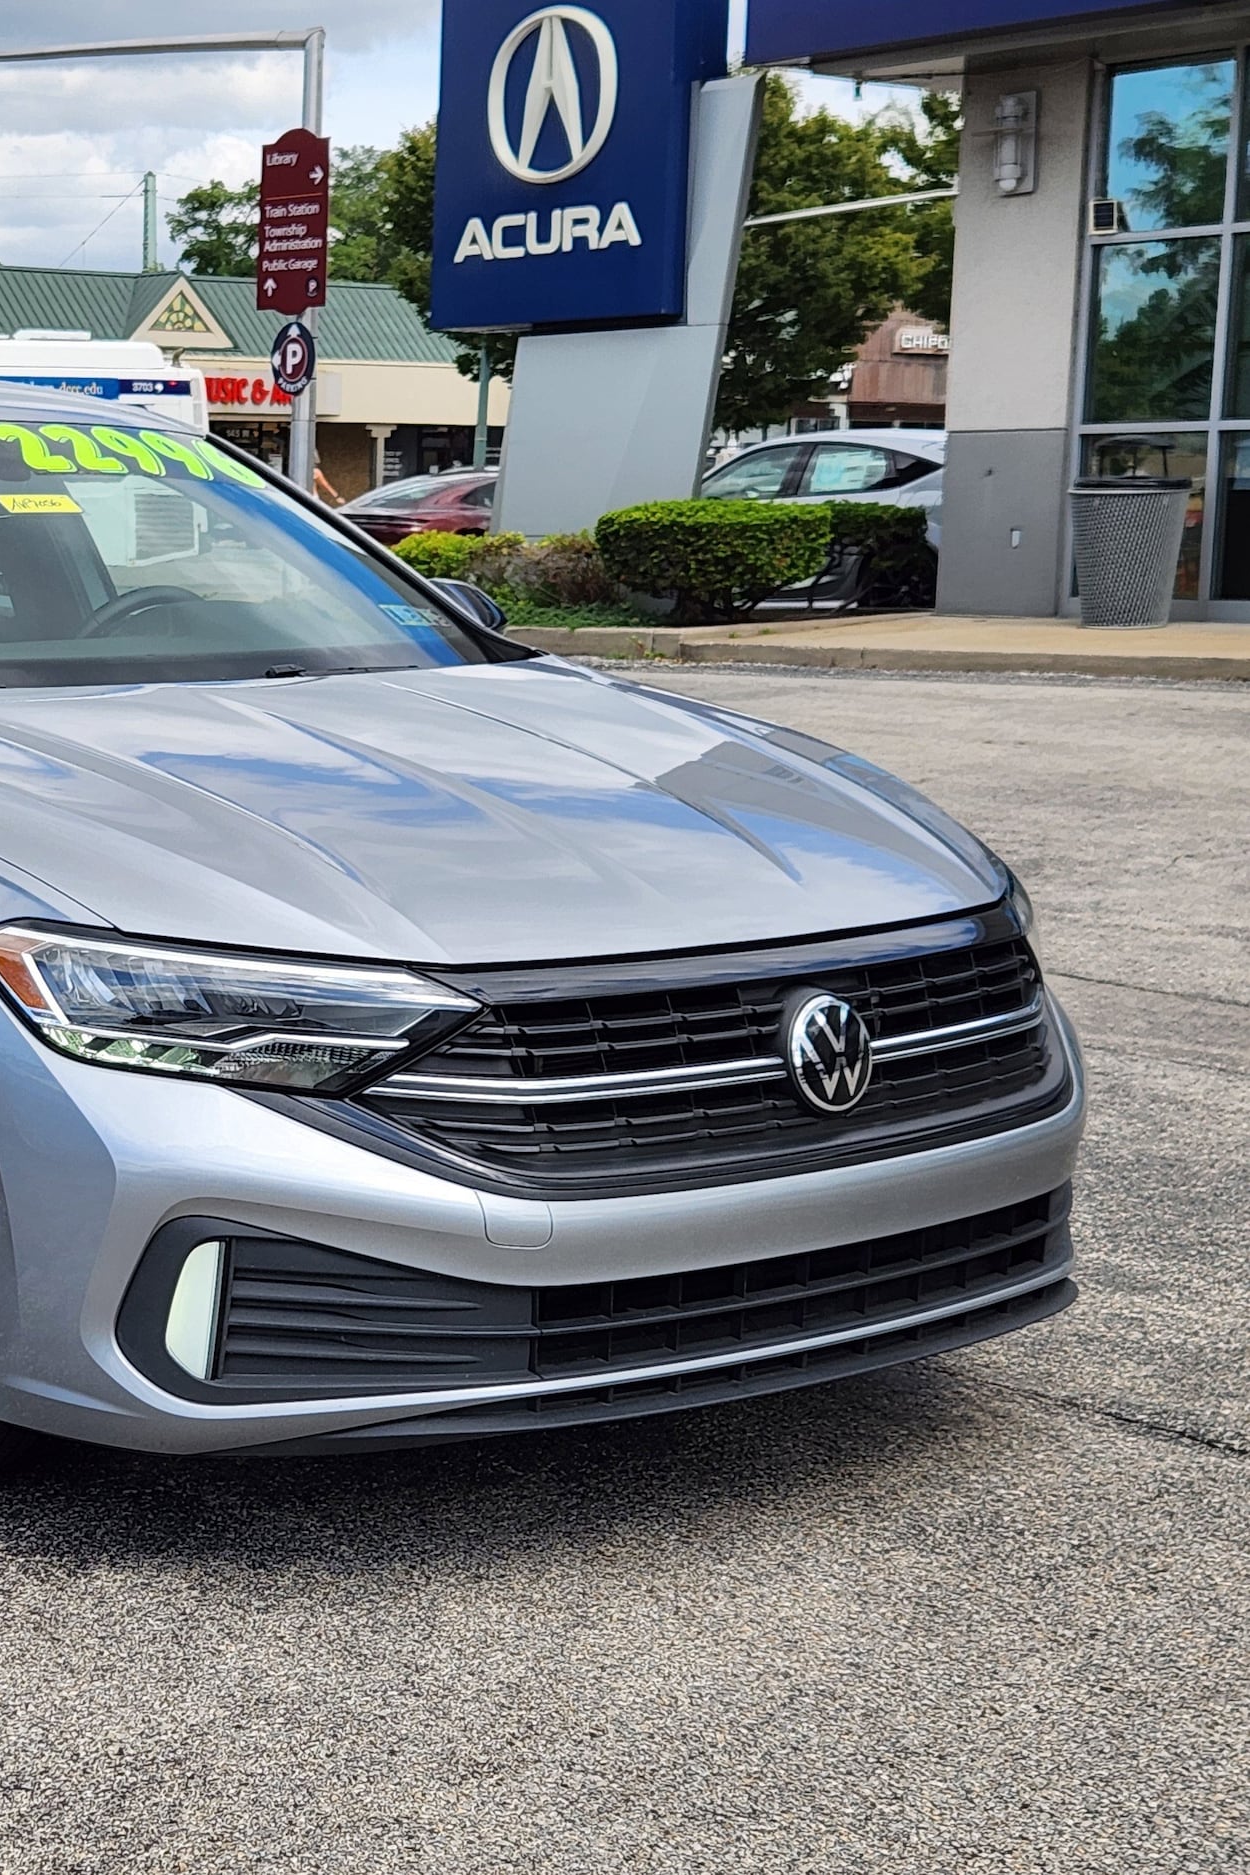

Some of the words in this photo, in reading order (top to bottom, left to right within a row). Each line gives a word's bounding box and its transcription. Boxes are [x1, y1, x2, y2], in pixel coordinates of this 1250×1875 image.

[266, 152, 299, 167] Library
[264, 205, 287, 218] Train
[288, 202, 320, 216] Station
[264, 224, 307, 238] Township
[453, 201, 642, 264] ACURA
[263, 238, 323, 252] Administration
[262, 260, 288, 272] Public
[288, 258, 318, 271] Garage
[901, 334, 949, 349] CHIPO
[286, 342, 303, 375] P
[205, 377, 248, 404] USIC
[251, 378, 270, 406] &
[277, 376, 308, 393] PARKING
